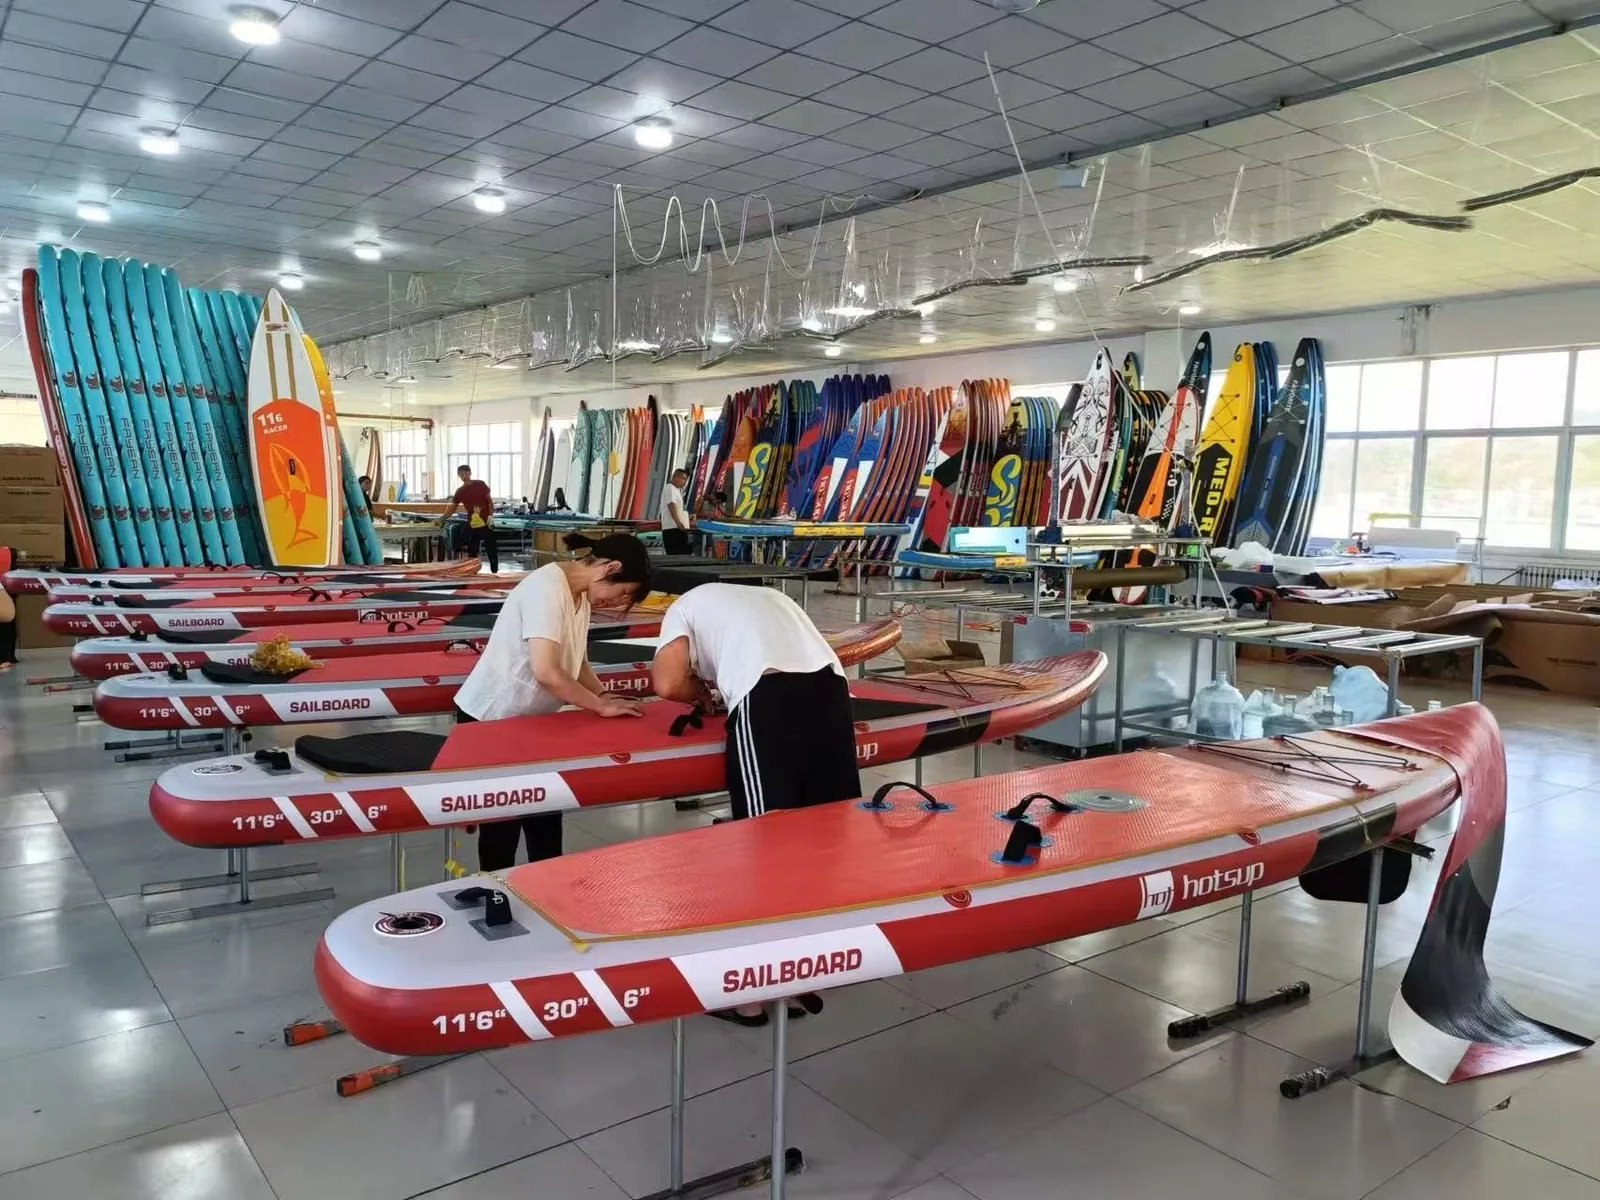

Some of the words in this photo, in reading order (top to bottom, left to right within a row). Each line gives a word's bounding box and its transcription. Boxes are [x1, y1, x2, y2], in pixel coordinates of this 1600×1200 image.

[74, 413, 94, 477] FAYEAN
[96, 415, 117, 478] FAYEAN
[121, 417, 140, 479] FAYEAN
[141, 419, 160, 480] FAYEAN
[163, 421, 182, 482] FAYEAN
[184, 421, 203, 481] FAYEAN
[203, 423, 223, 481] FAYEAN
[263, 424, 288, 435] RACER
[168, 617, 224, 627] SAILBOARD
[290, 697, 370, 713] SAILBOARD
[441, 786, 546, 813] SAILBOARD
[1182, 861, 1265, 900] hotsup
[723, 948, 862, 993] SAILBOARD
